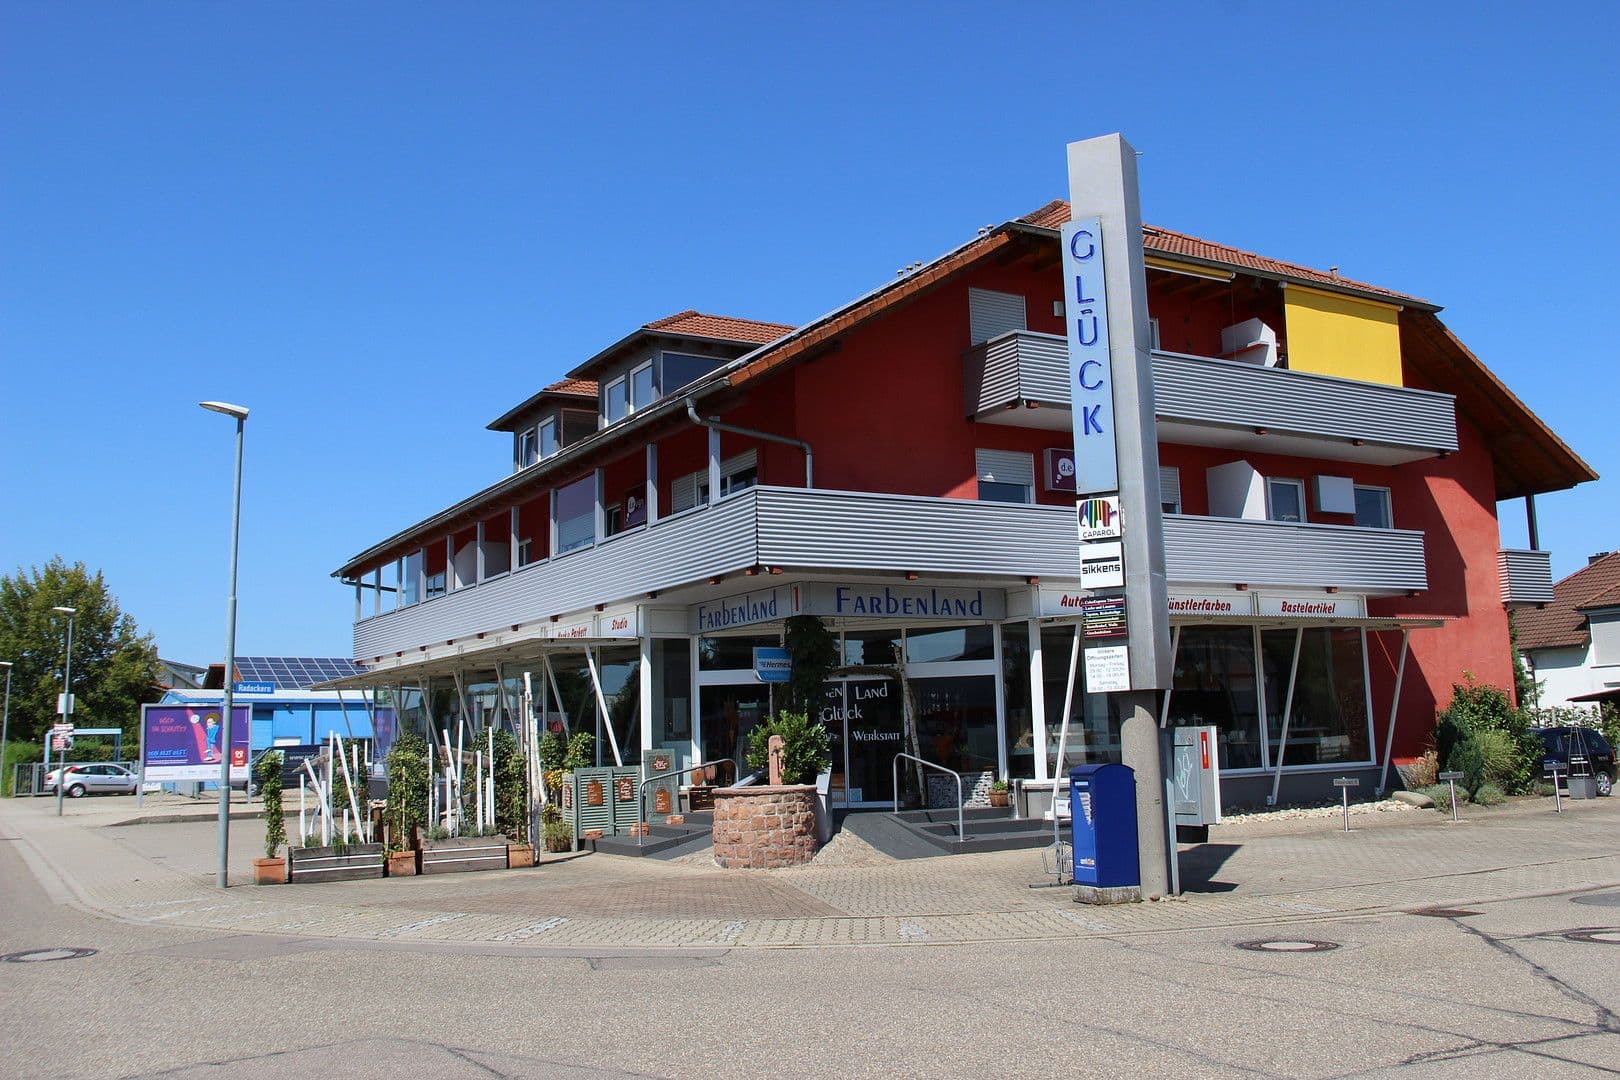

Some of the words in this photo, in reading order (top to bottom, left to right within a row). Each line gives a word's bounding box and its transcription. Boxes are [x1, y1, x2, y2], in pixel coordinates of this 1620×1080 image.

[1070, 230, 1104, 435] GLÜCK
[1082, 528, 1116, 539] CAPAROL
[1081, 563, 1121, 575] sikkens
[1168, 597, 1232, 611] ünstlerfarben
[1281, 601, 1336, 614] Bastelartikel
[612, 617, 628, 630] Studio
[821, 704, 864, 722] Glück
